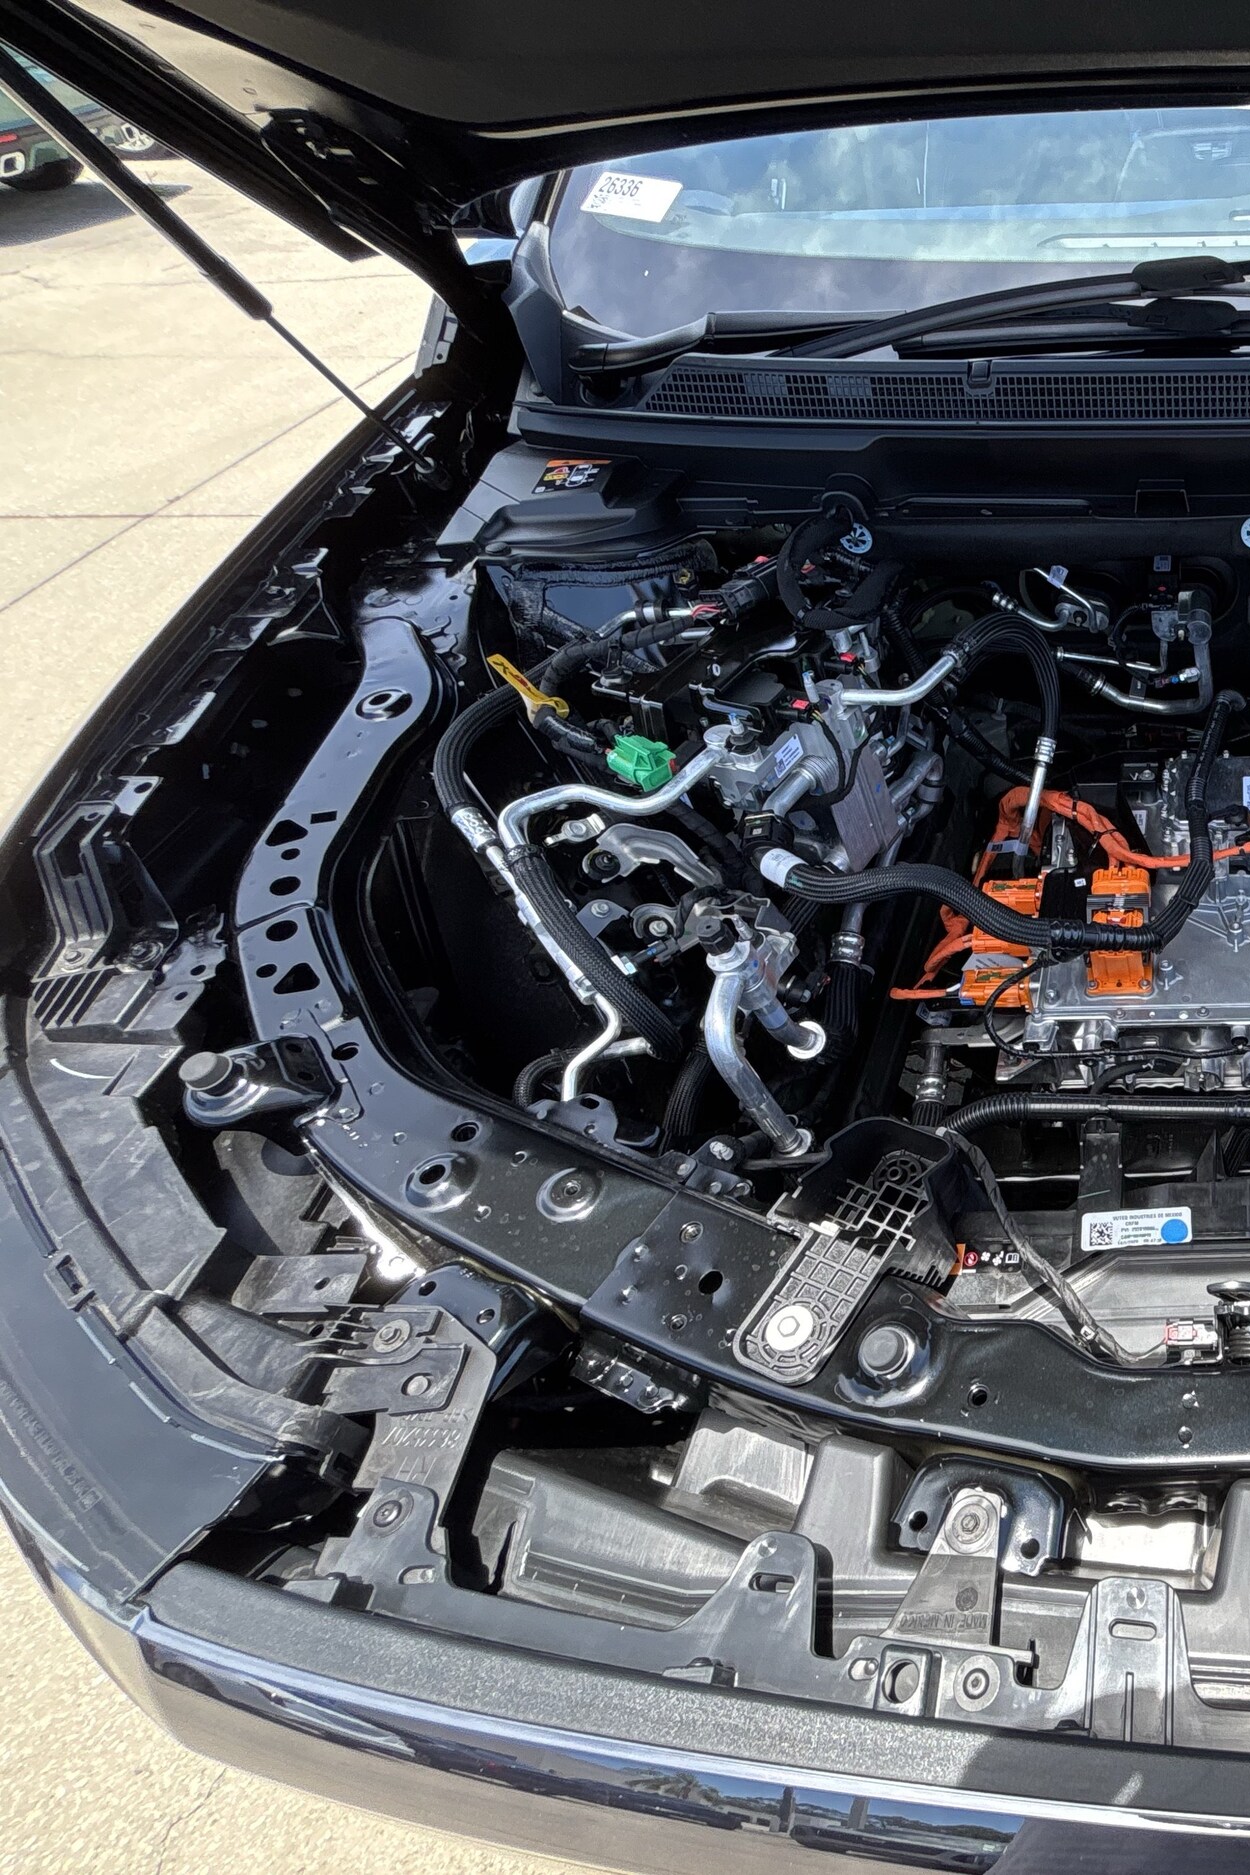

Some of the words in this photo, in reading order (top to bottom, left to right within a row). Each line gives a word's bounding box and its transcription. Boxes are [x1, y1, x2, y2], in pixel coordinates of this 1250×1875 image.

[598, 176, 643, 197] 26336
[900, 1612, 939, 1629] MEXICO
[943, 1613, 955, 1628] IN
[958, 1613, 988, 1628] MADE
